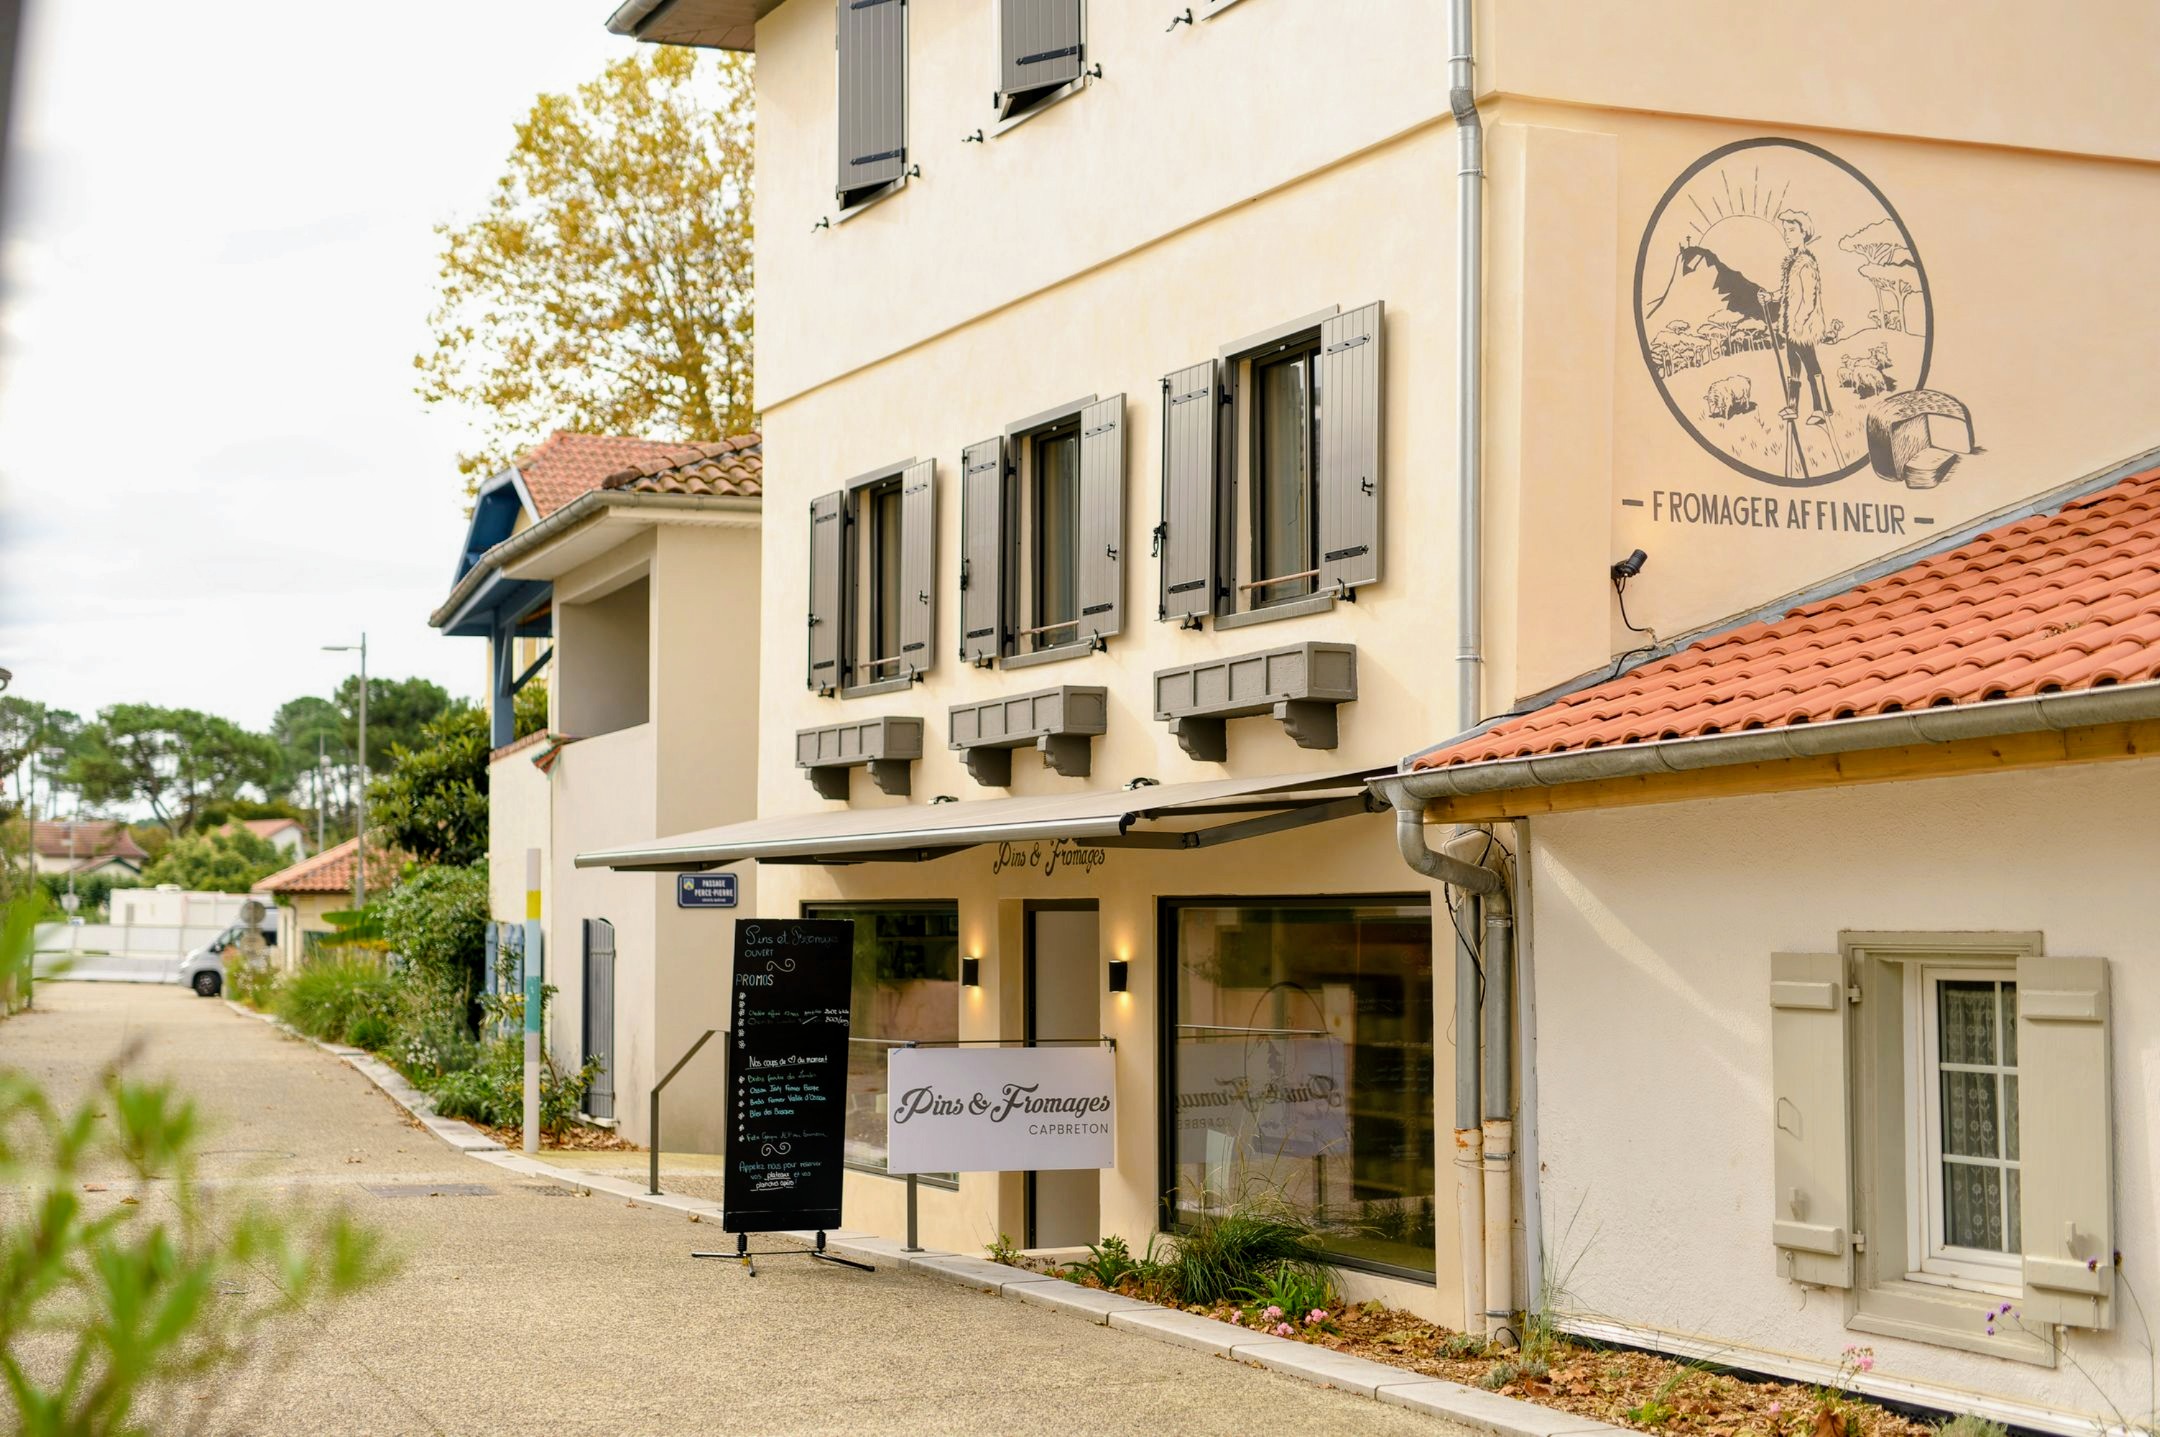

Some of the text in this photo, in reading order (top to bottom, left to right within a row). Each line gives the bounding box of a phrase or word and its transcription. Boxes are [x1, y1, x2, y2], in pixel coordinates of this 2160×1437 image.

[1653, 490, 1905, 535] FROMAGER AFFINEUR
[993, 838, 1105, 877] Pins & Fromages
[702, 879, 726, 888] PASSAGE
[744, 948, 774, 957] OUVERT
[735, 973, 775, 986] PROMOS
[749, 1055, 762, 1067] Nos
[893, 1083, 1111, 1124] Pins & Fromages
[1028, 1123, 1109, 1136] CAPBRETON
